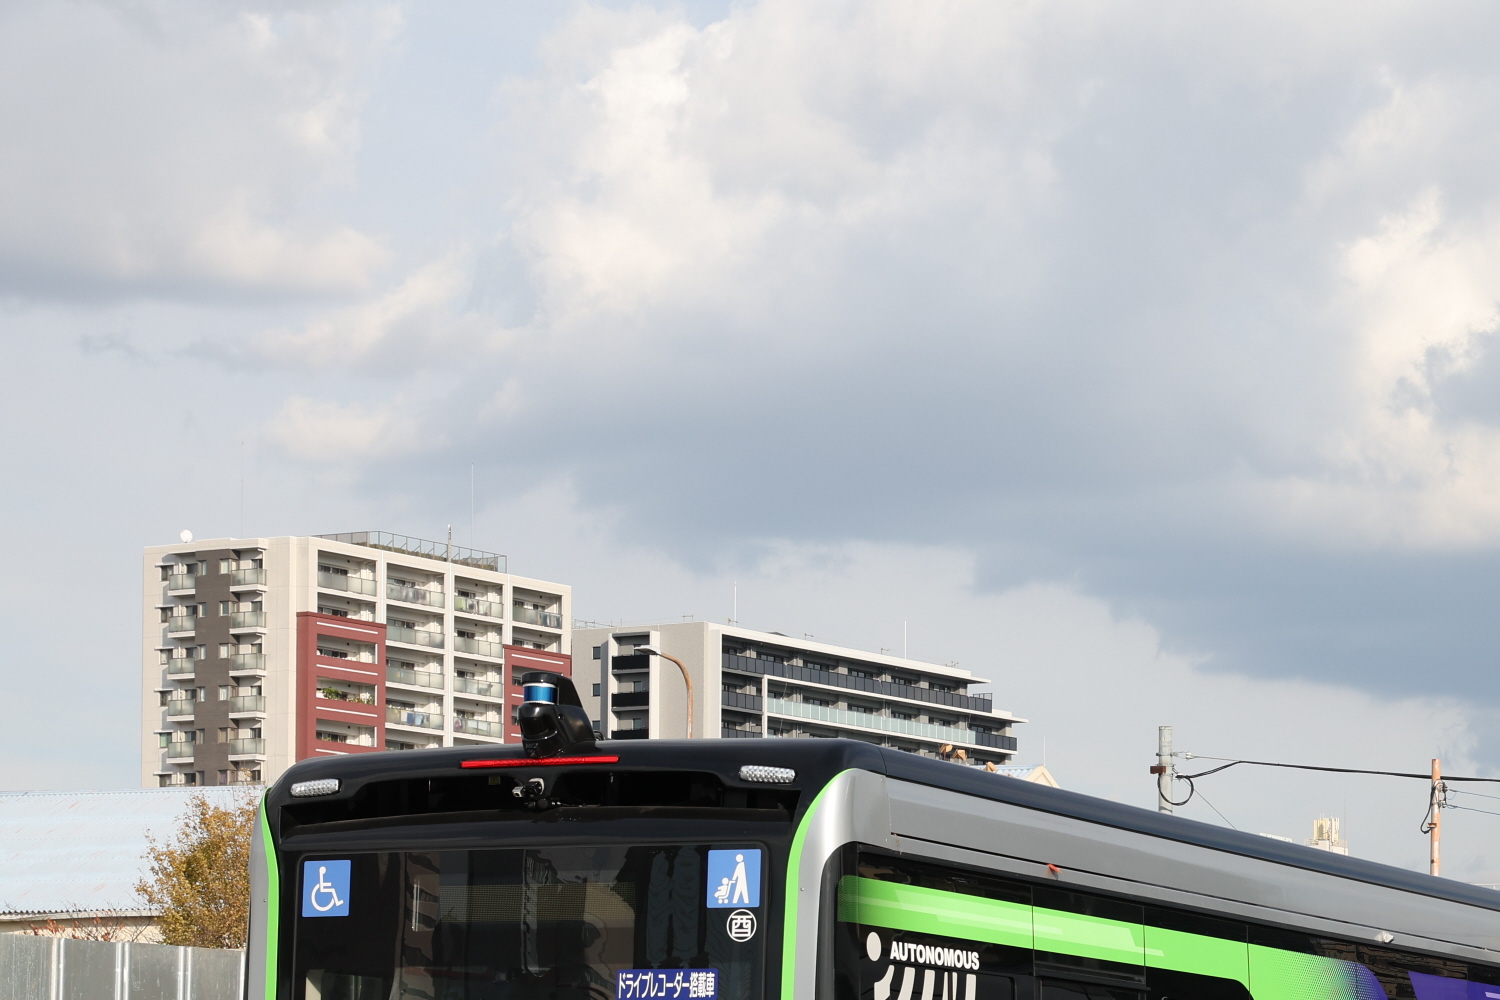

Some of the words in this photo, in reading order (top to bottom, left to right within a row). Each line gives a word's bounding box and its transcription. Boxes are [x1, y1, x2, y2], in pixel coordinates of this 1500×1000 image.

[889, 941, 980, 970] AUTONOMOUS
[618, 971, 716, 999] ドライブレコーダー搭載車
